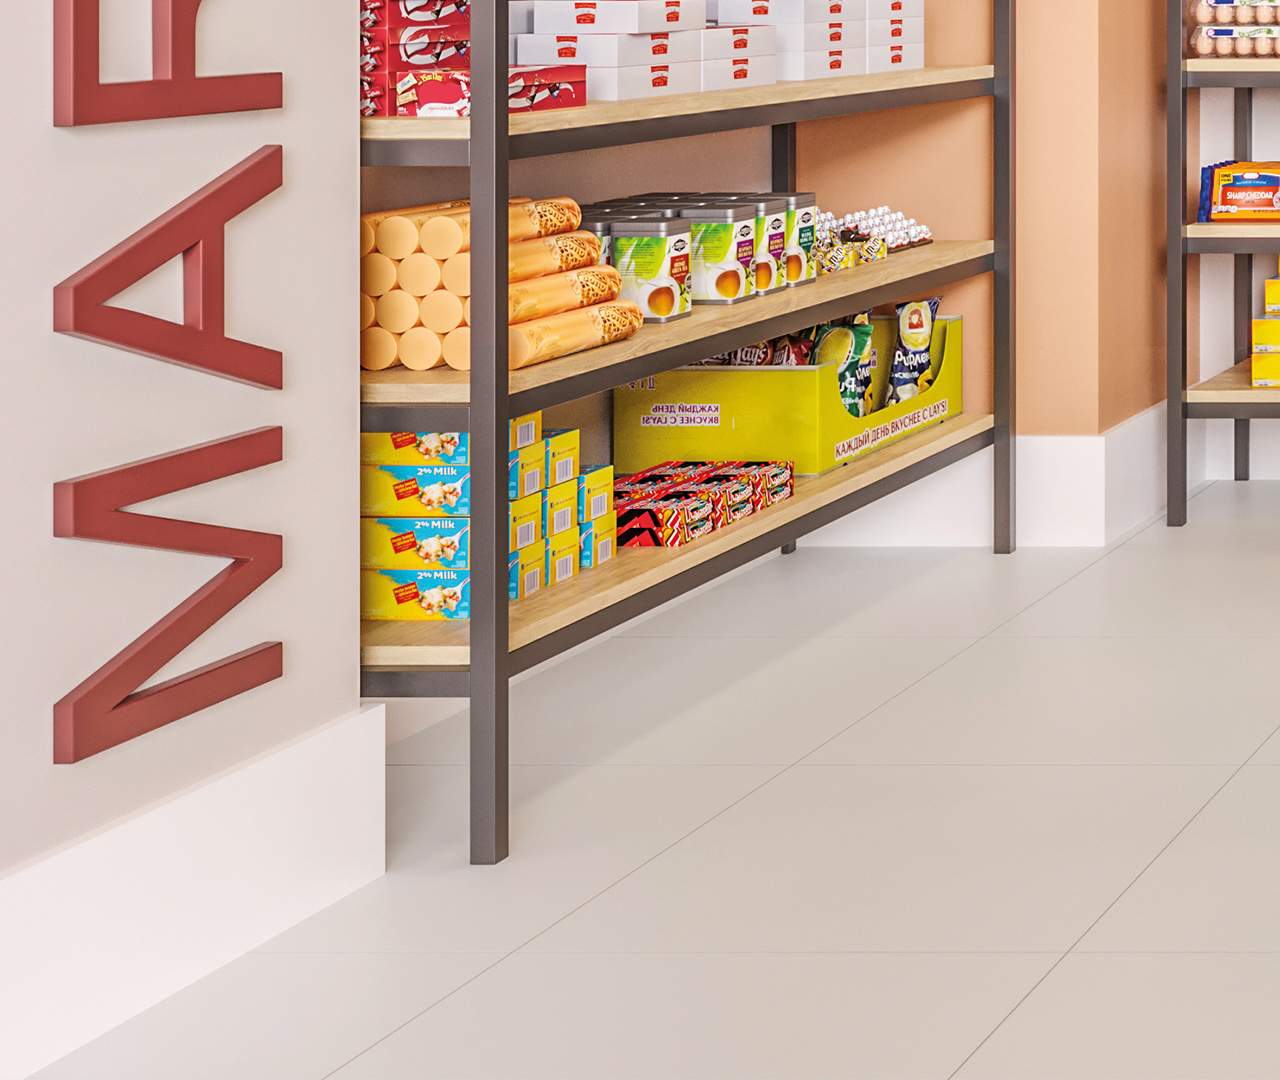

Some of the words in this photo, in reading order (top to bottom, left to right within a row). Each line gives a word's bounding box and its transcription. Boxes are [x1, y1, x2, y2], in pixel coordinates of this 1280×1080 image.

[1227, 191, 1246, 199] SHARP
[1247, 191, 1273, 199] CHEDDAR
[836, 430, 869, 456] КАЖДЫЙ
[870, 425, 889, 443] ДЕНЬ
[890, 411, 921, 434] ВКУСНЕЕ
[434, 467, 457, 475] Milk
[431, 520, 455, 529] Milk
[434, 572, 457, 580] Milk
